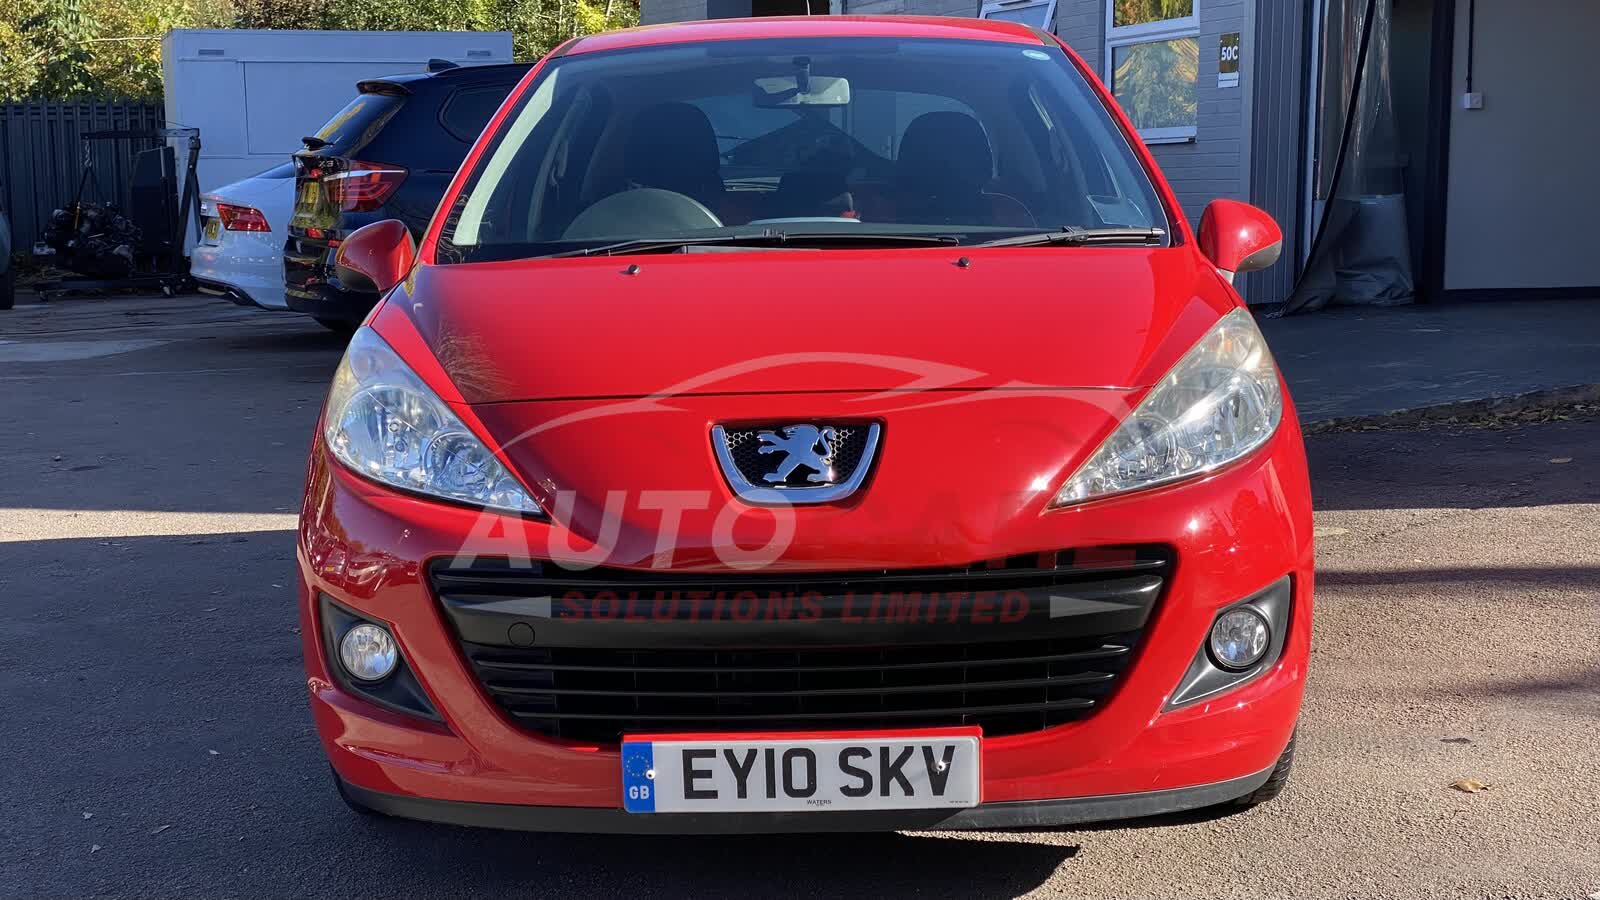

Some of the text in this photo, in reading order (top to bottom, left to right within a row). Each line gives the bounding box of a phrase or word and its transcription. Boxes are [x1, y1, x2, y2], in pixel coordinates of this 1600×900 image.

[1221, 45, 1238, 60] 50C
[682, 745, 956, 799] EY10 SKV
[629, 785, 650, 799] GB
